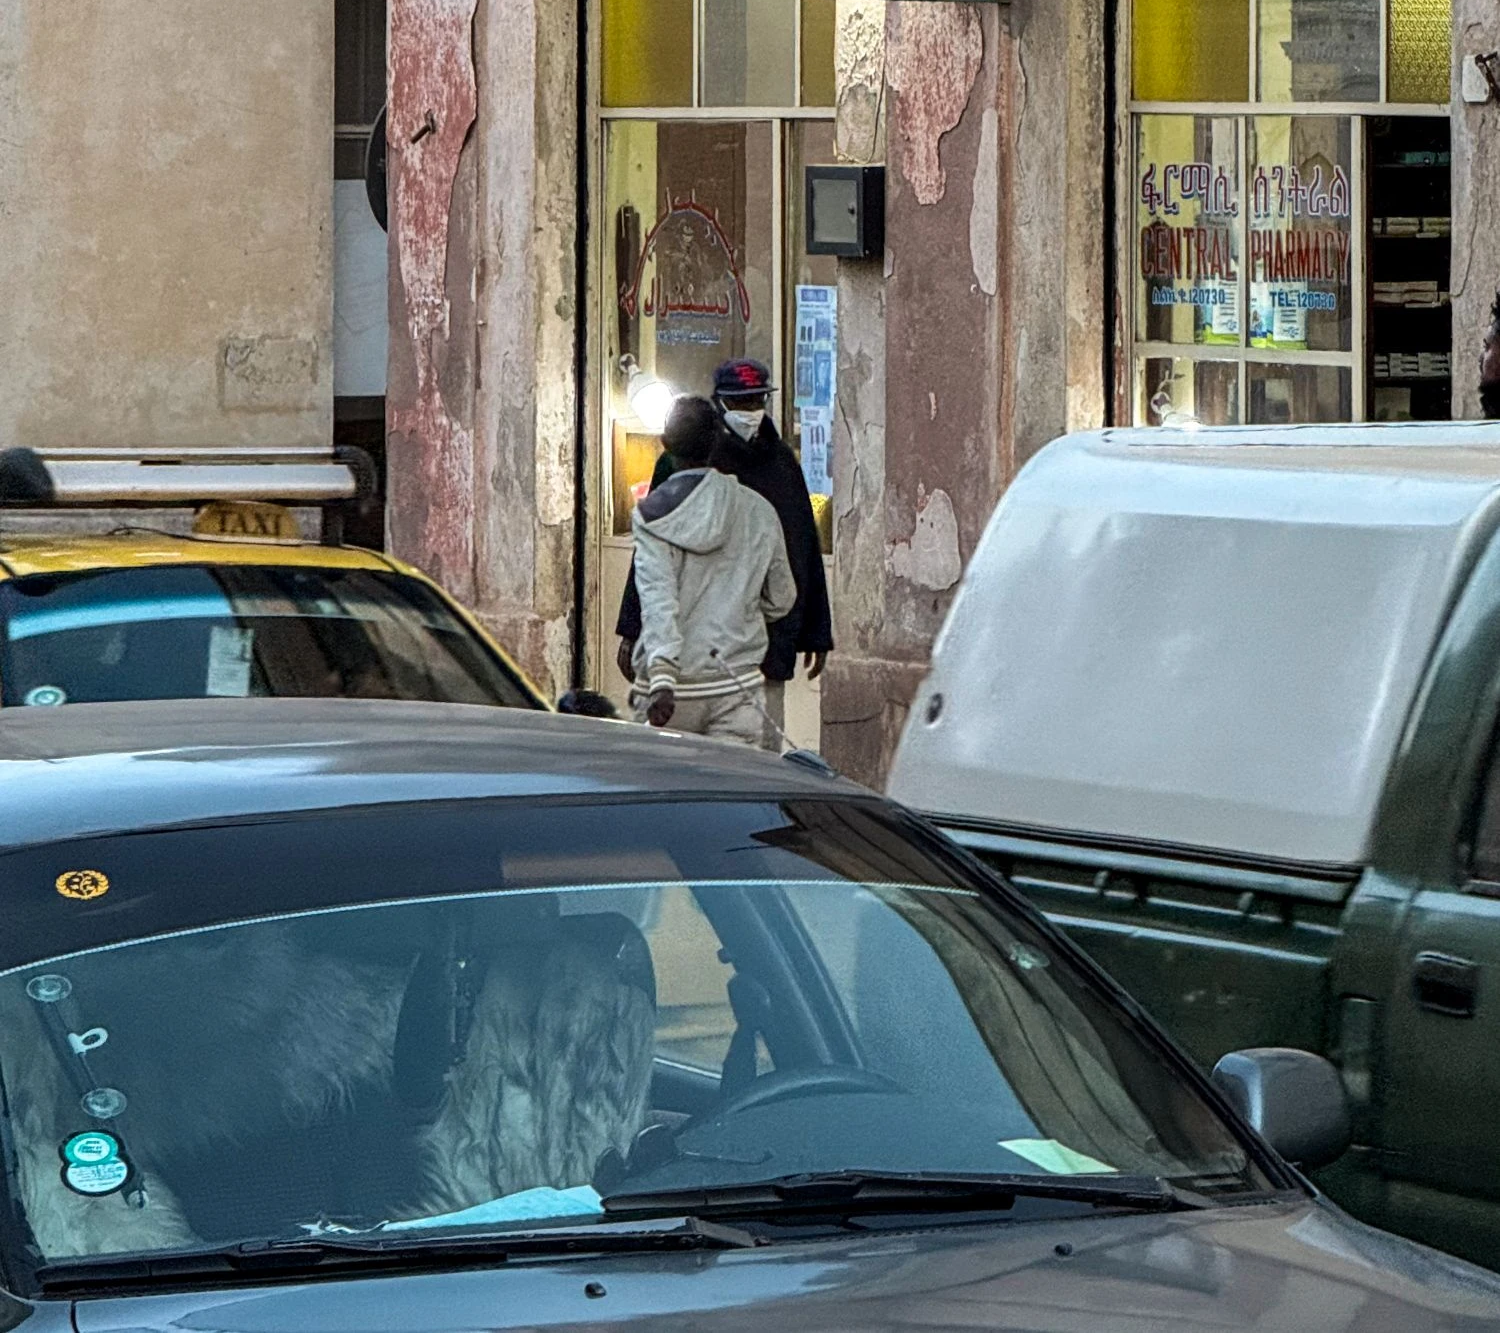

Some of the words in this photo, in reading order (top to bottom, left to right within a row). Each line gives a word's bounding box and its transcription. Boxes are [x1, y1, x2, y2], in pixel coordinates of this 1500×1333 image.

[1141, 162, 1239, 216] ፋርማሲ
[1140, 225, 1238, 280] CENTRAL
[1250, 228, 1351, 283] PHARMACY
[215, 509, 281, 536] TAXI
